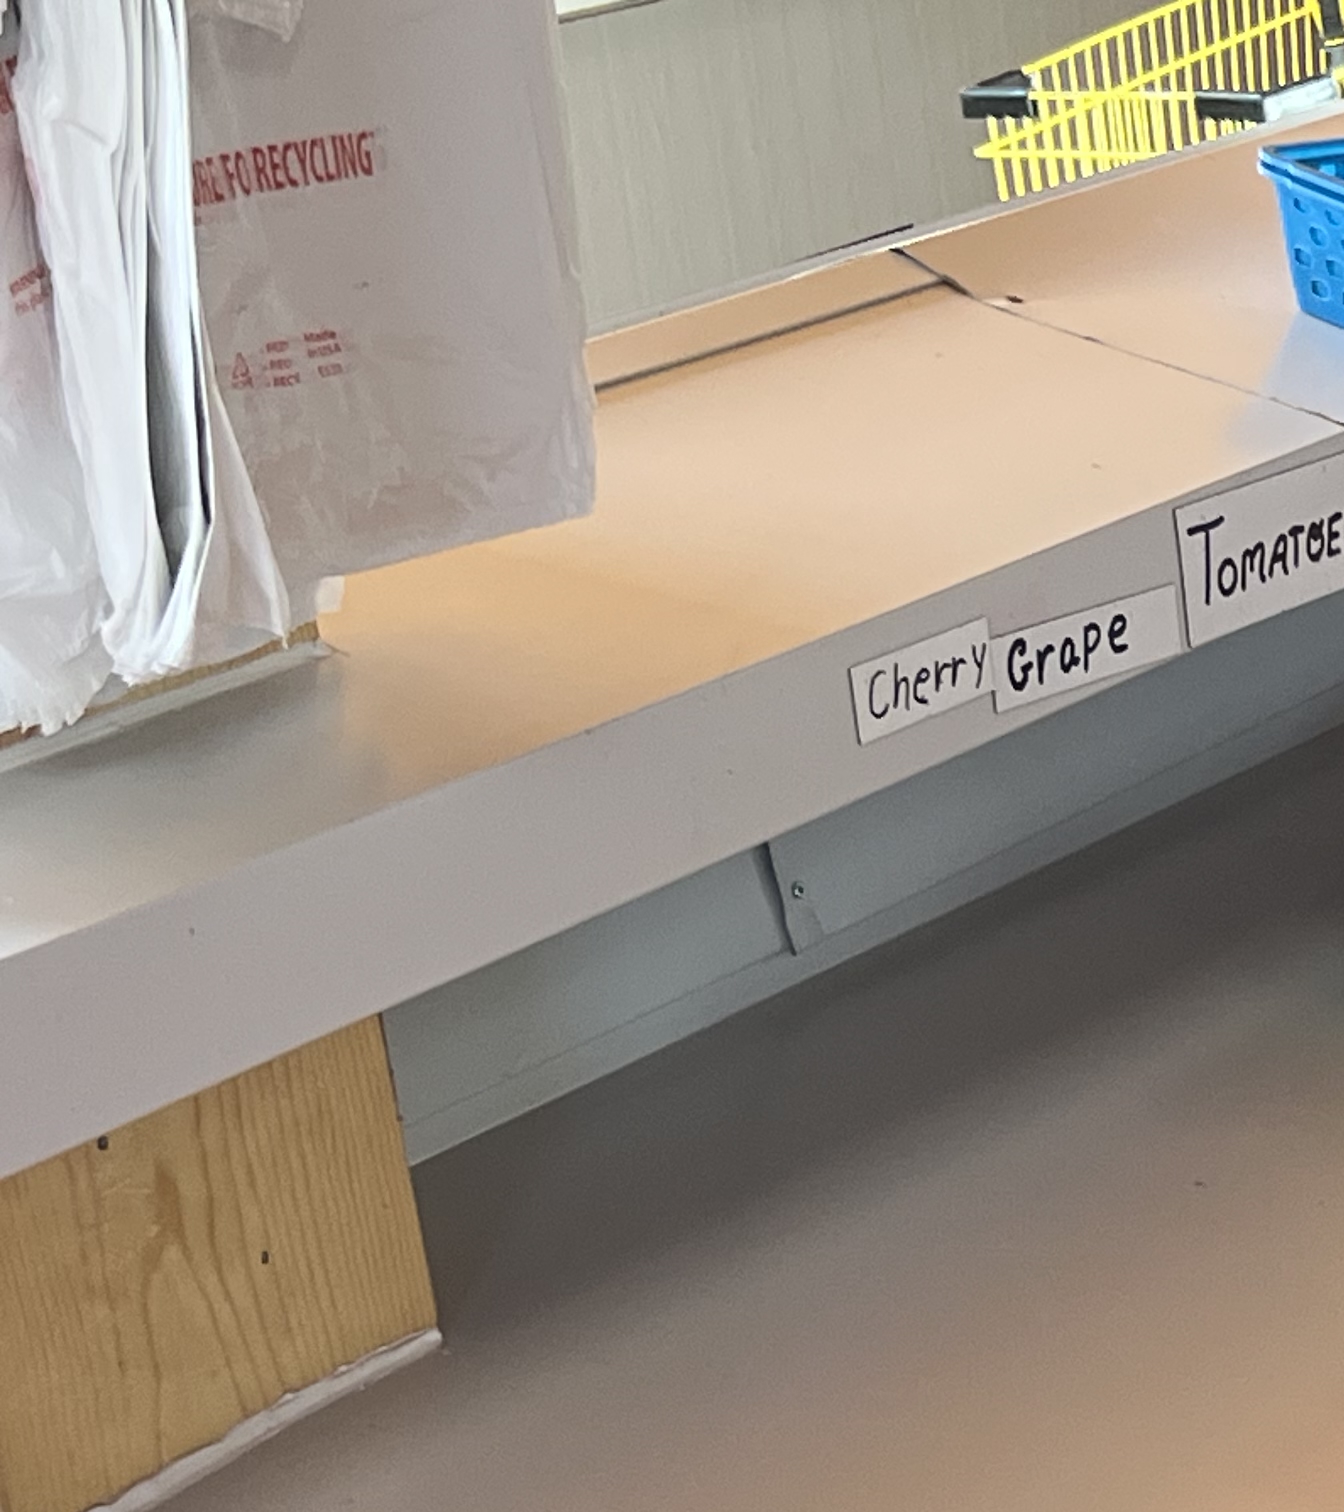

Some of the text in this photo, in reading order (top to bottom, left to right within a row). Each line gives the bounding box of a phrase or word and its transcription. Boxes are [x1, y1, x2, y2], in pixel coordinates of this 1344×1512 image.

[251, 130, 374, 192] RECYCLING
[868, 613, 1129, 719] Cherry Grape
